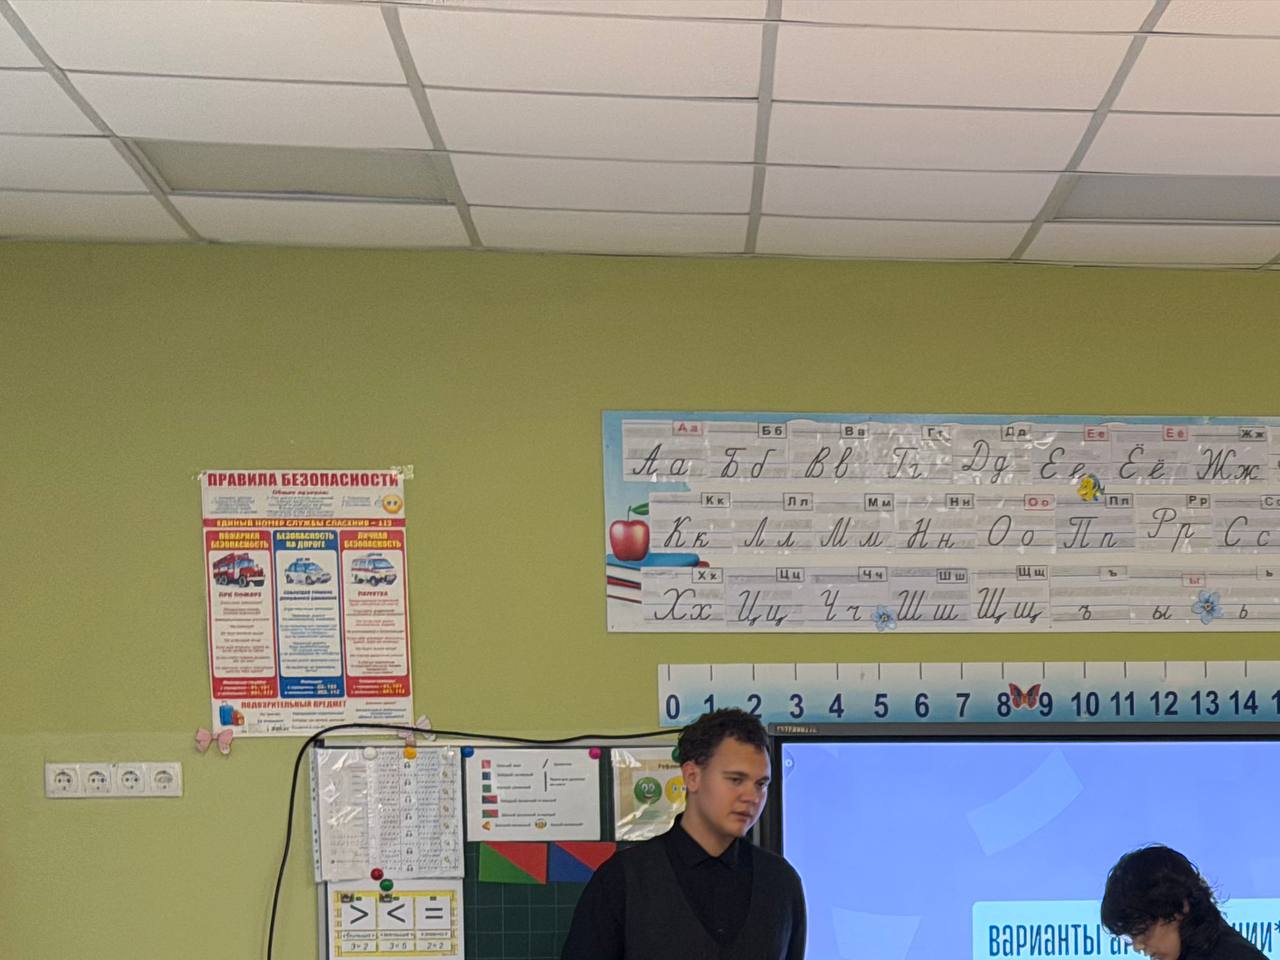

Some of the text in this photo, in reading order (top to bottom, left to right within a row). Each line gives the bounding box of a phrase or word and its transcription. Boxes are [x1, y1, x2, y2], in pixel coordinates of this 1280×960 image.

[207, 472, 399, 487] ПРАВИЛА БЕЗОПАСНОСТИ
[666, 694, 681, 720] 0
[747, 694, 762, 718] 2
[789, 694, 805, 719] 3
[829, 693, 845, 718] 4
[874, 693, 889, 718] 5
[915, 693, 930, 718] 6
[956, 692, 971, 718] 7
[997, 692, 1012, 718] 8
[1039, 692, 1054, 717] 9
[1071, 691, 1100, 717] 10
[1110, 691, 1135, 716] 11
[1150, 691, 1178, 716] 12
[1192, 690, 1220, 715] 13
[1229, 690, 1259, 715] 14
[988, 924, 1100, 957] варианты
